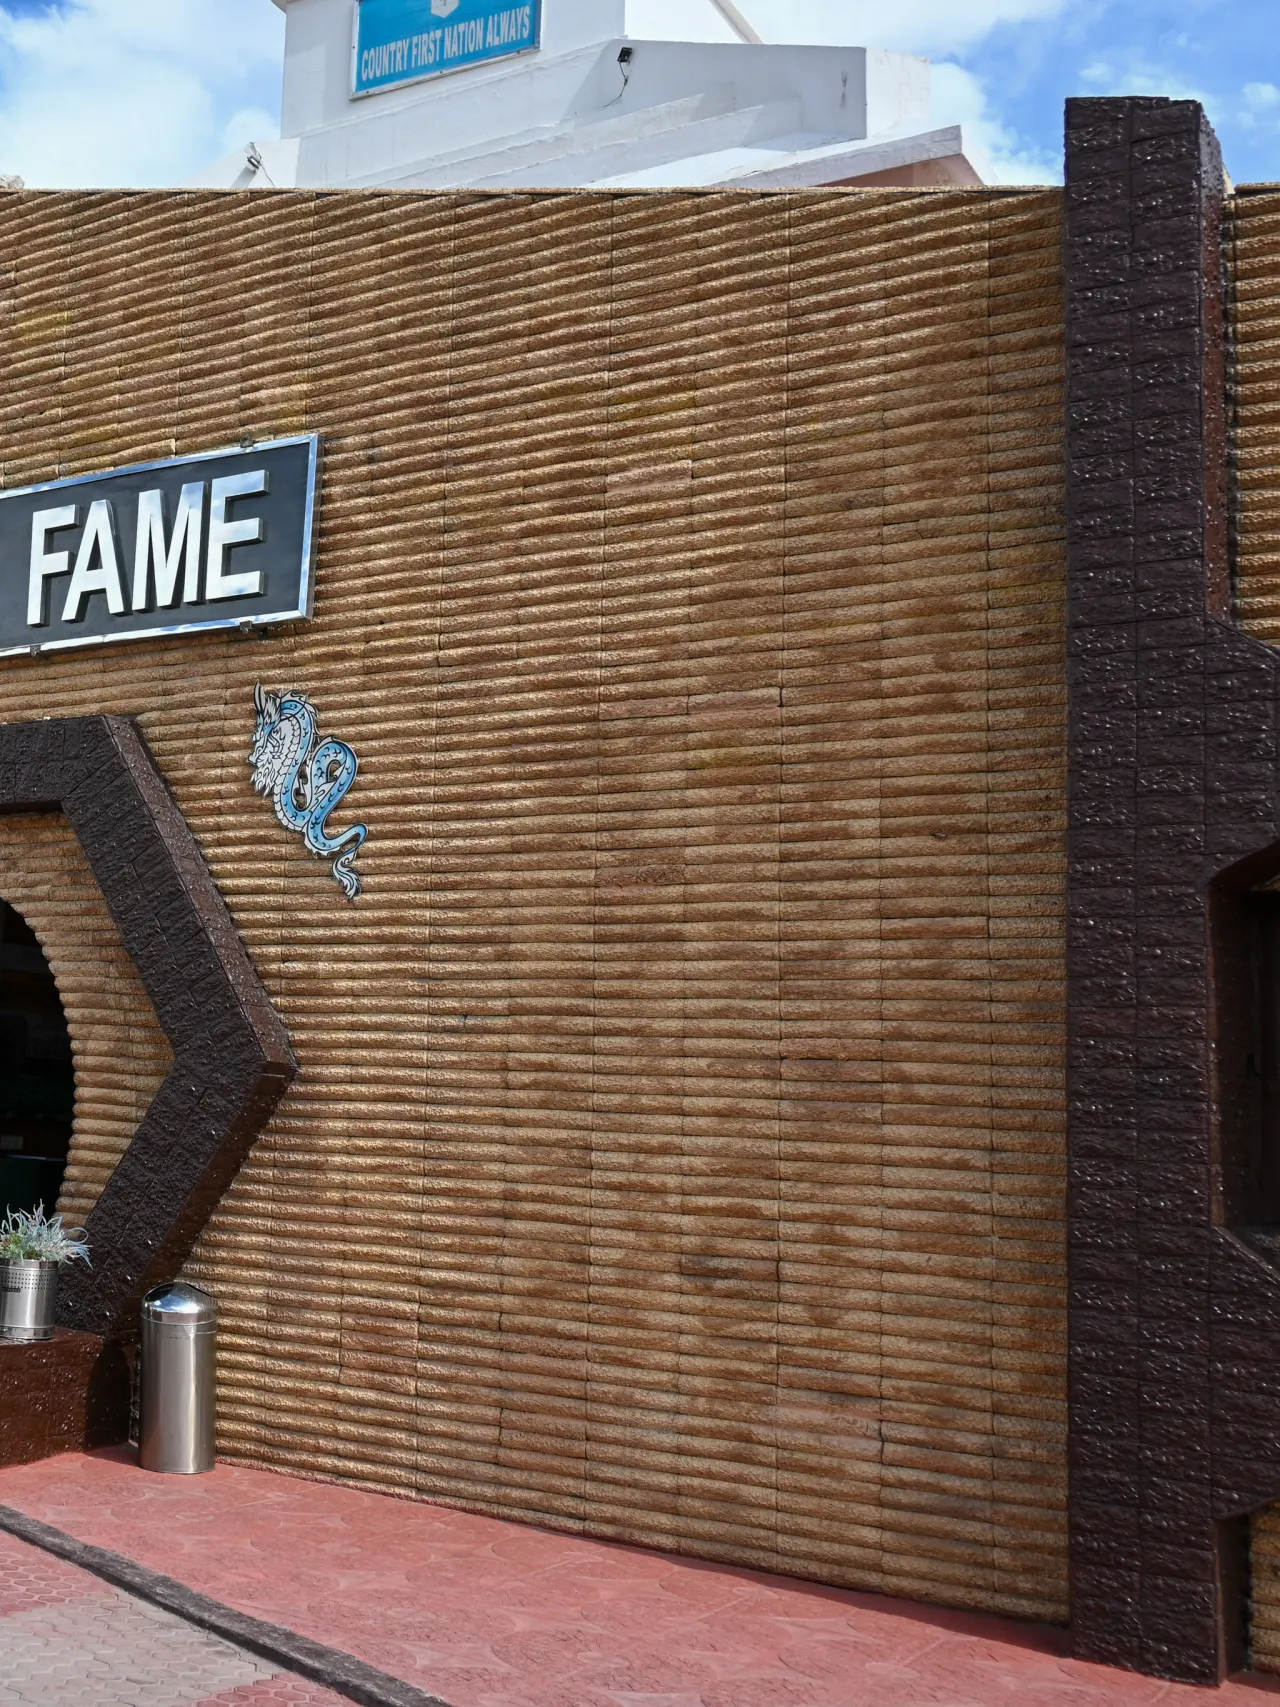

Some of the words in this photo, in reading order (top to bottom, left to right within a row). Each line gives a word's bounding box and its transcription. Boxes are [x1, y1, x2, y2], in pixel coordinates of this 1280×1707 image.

[362, 38, 410, 81] COUNTRY
[412, 30, 442, 68] FIRST
[444, 18, 484, 58] NATION
[486, 6, 530, 47] ALWAYS
[27, 469, 269, 627] FAME
